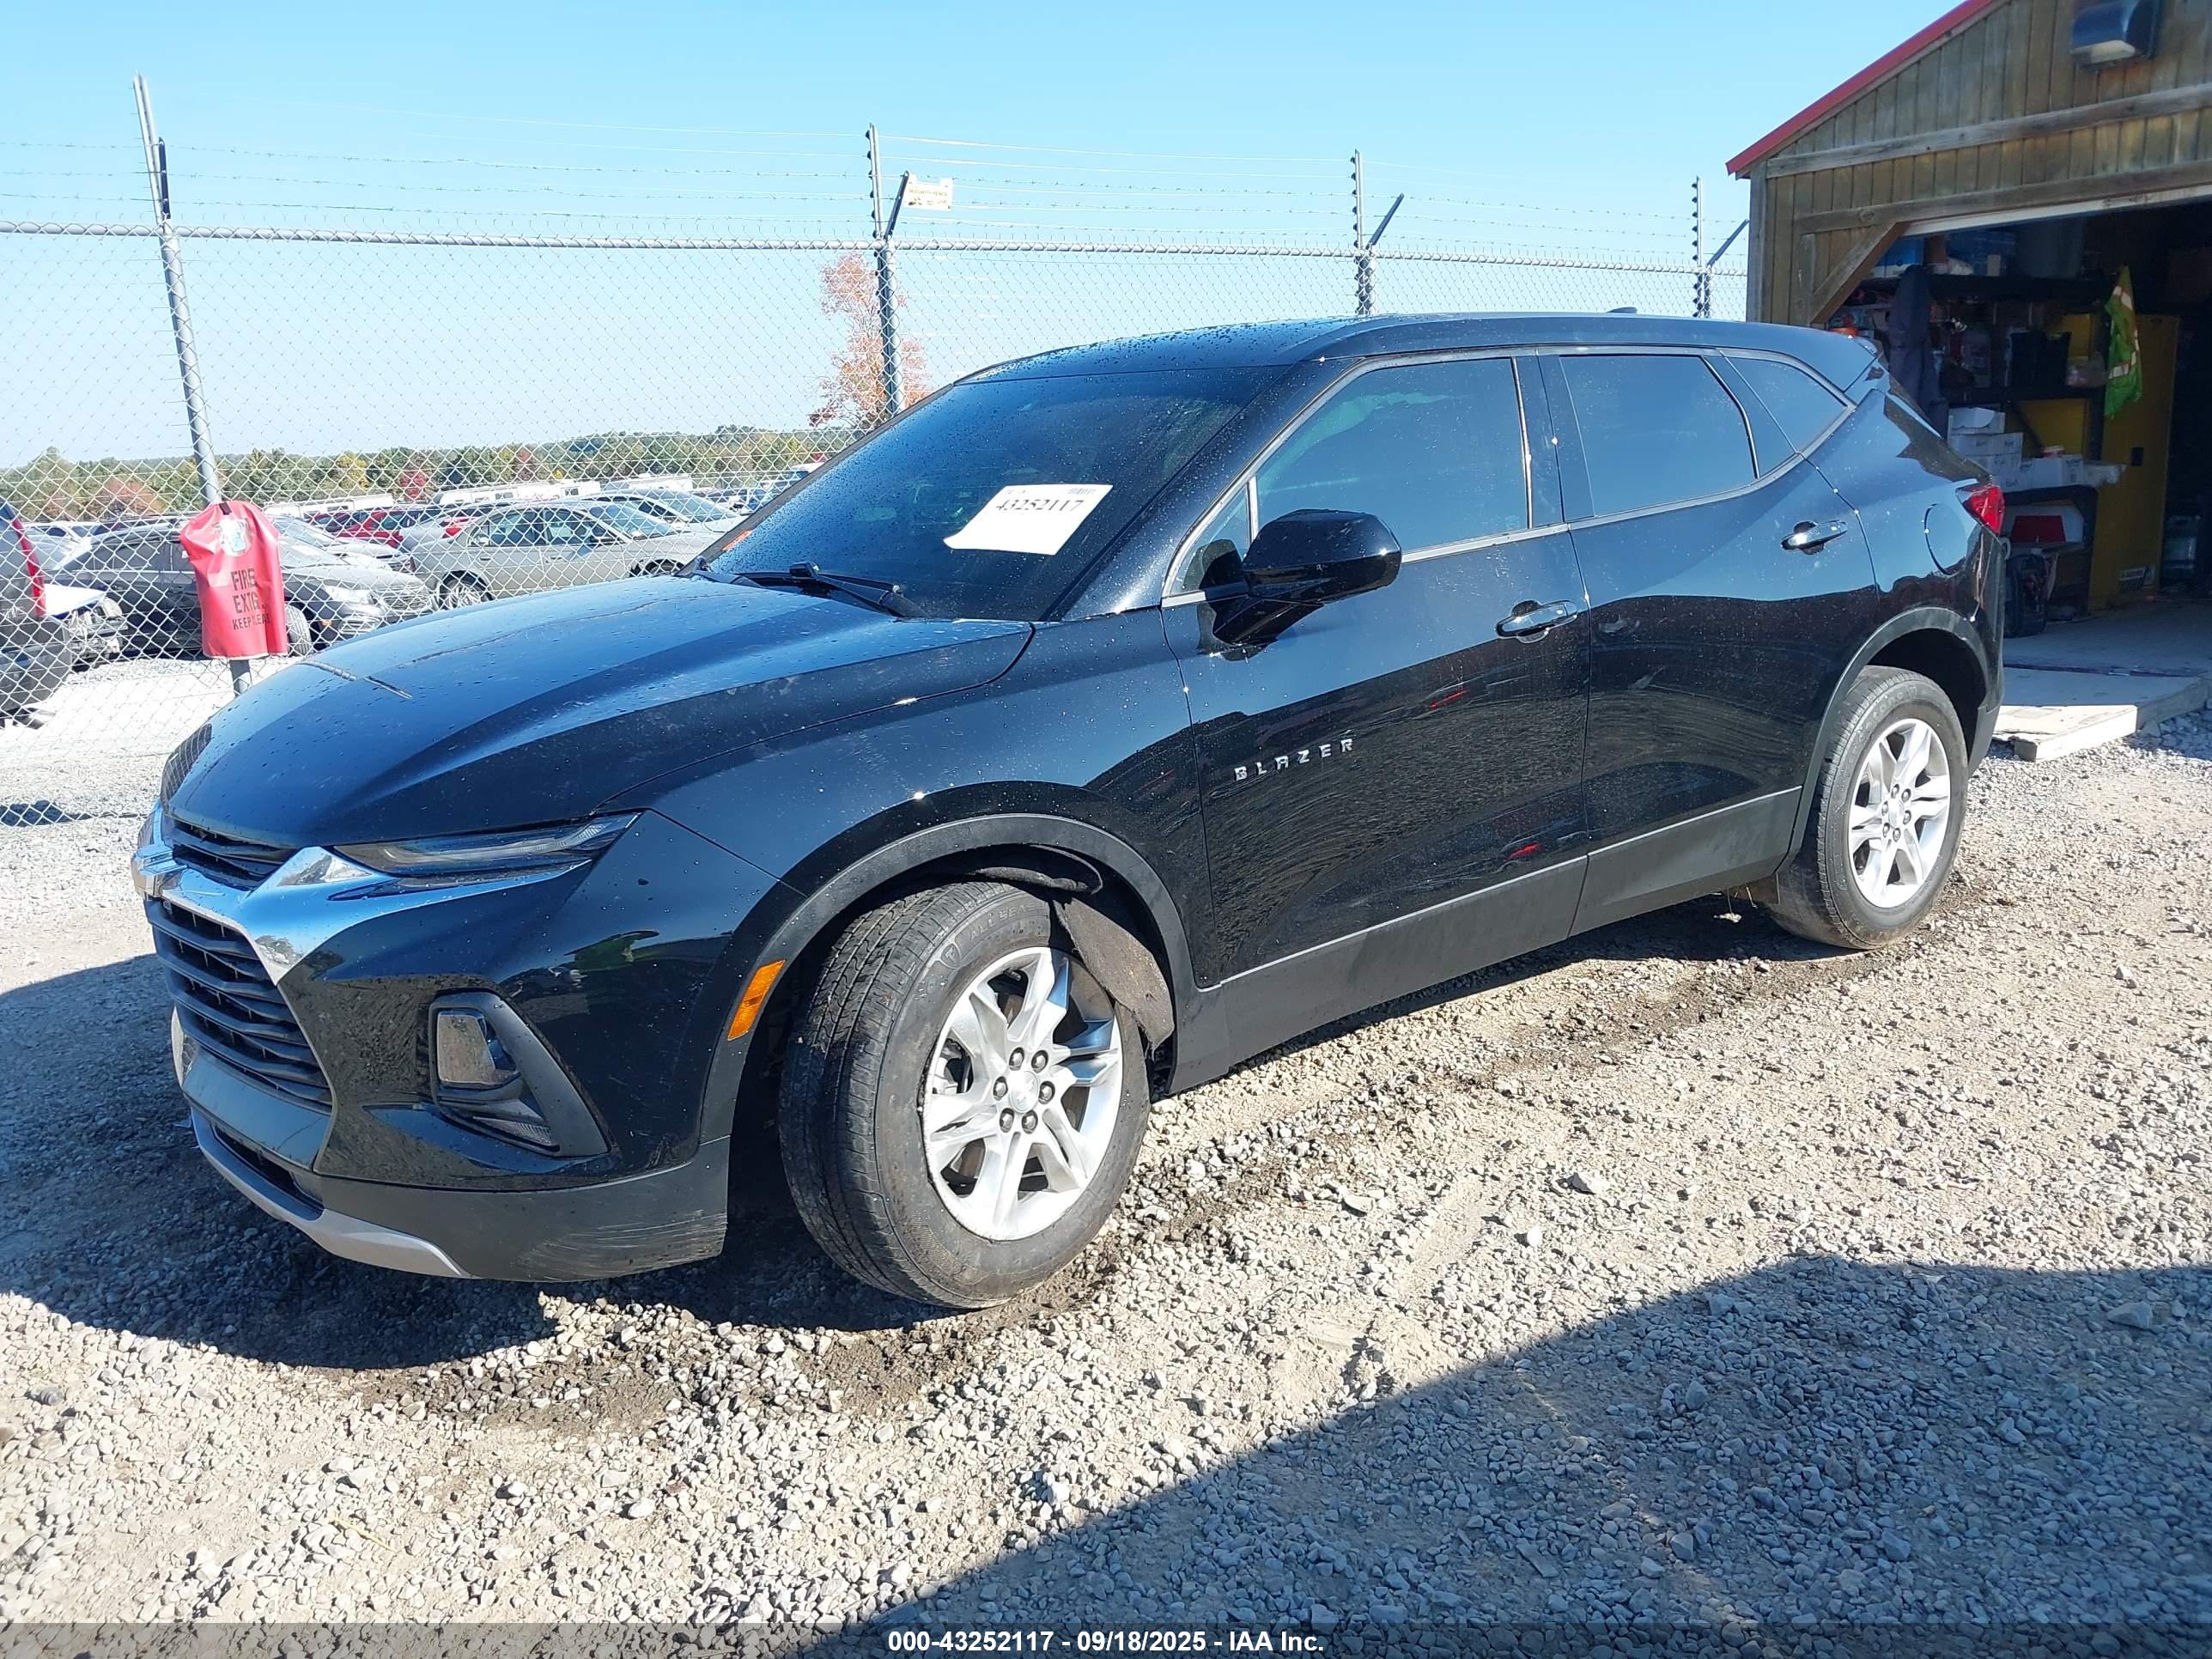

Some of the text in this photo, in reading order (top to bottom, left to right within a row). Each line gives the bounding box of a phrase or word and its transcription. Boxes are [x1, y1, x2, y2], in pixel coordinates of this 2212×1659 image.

[996, 499, 1085, 512] 43252117
[230, 568, 255, 591] FIRE
[232, 617, 251, 630] KEEP
[1234, 738, 1353, 781] BLAZER
